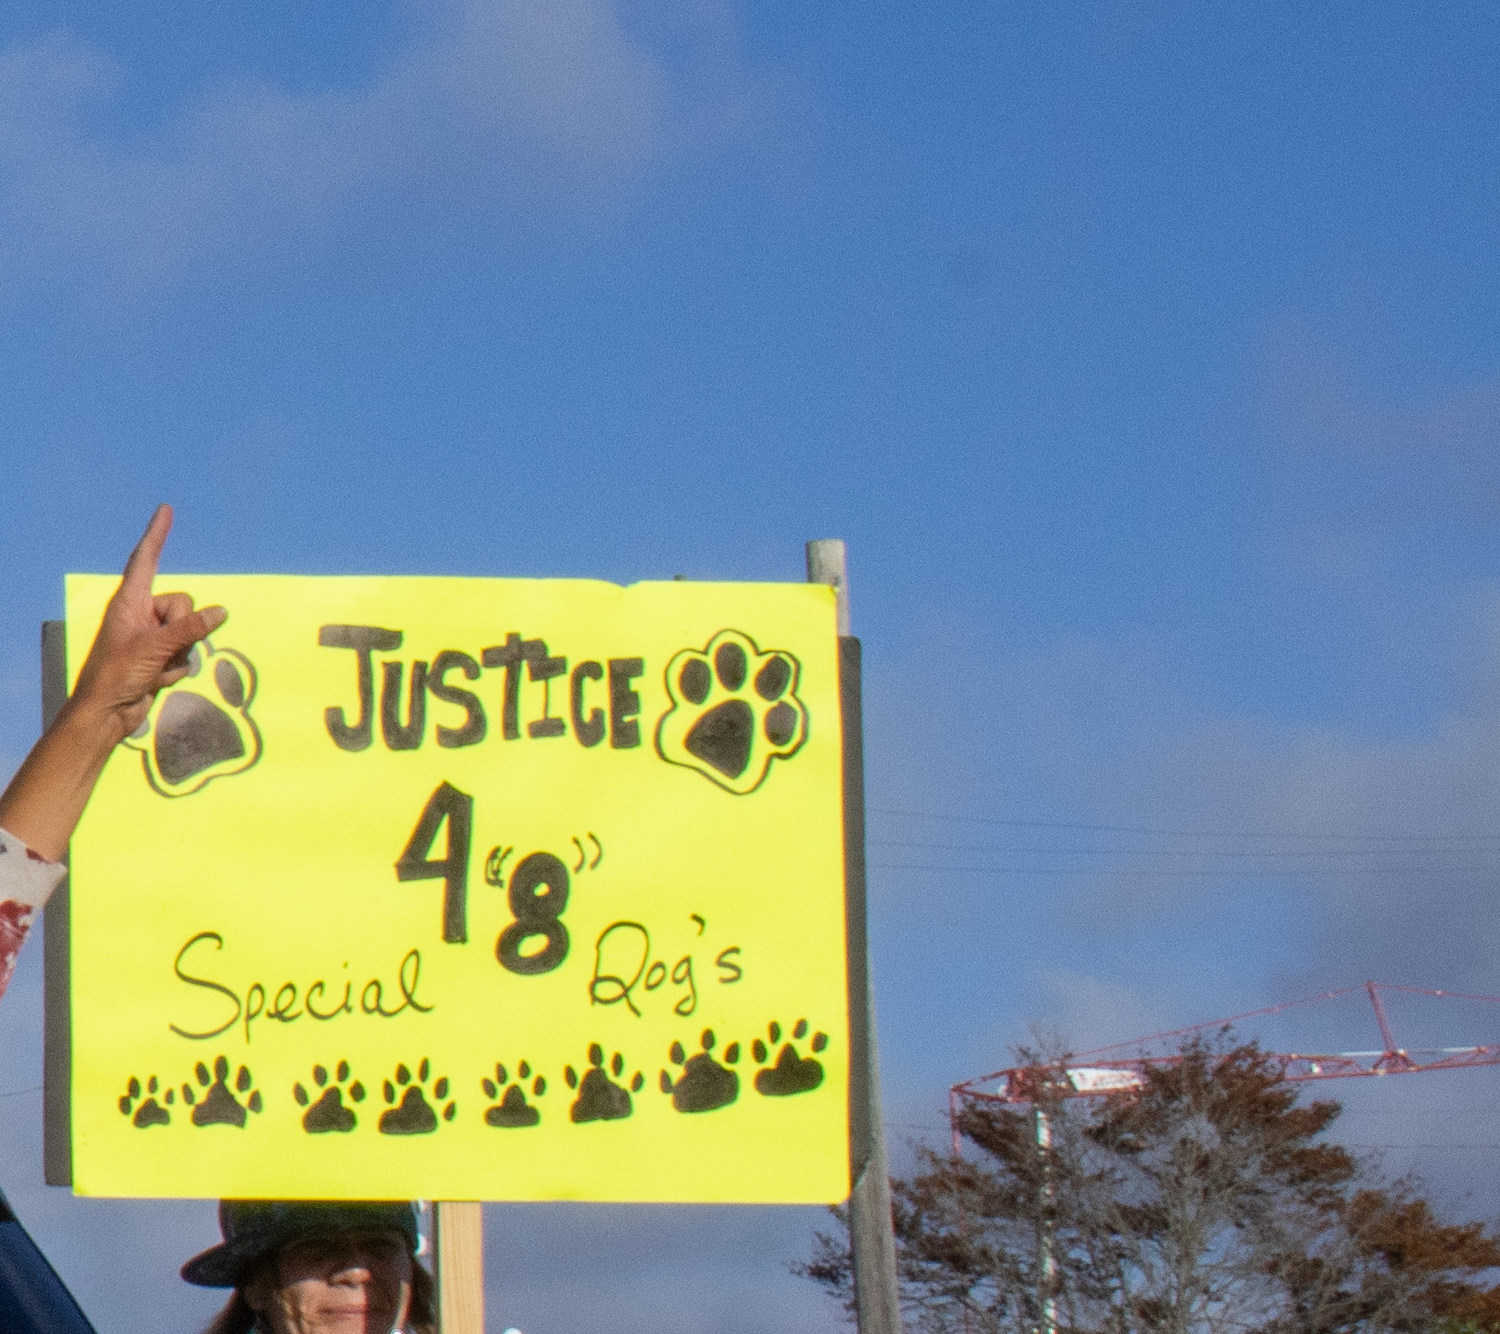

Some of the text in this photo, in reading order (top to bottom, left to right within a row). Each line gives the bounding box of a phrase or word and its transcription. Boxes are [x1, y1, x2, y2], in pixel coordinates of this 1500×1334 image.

[318, 624, 643, 752] JUSTICE
[395, 780, 474, 944] 4
[169, 914, 743, 1041] Special Dog's
